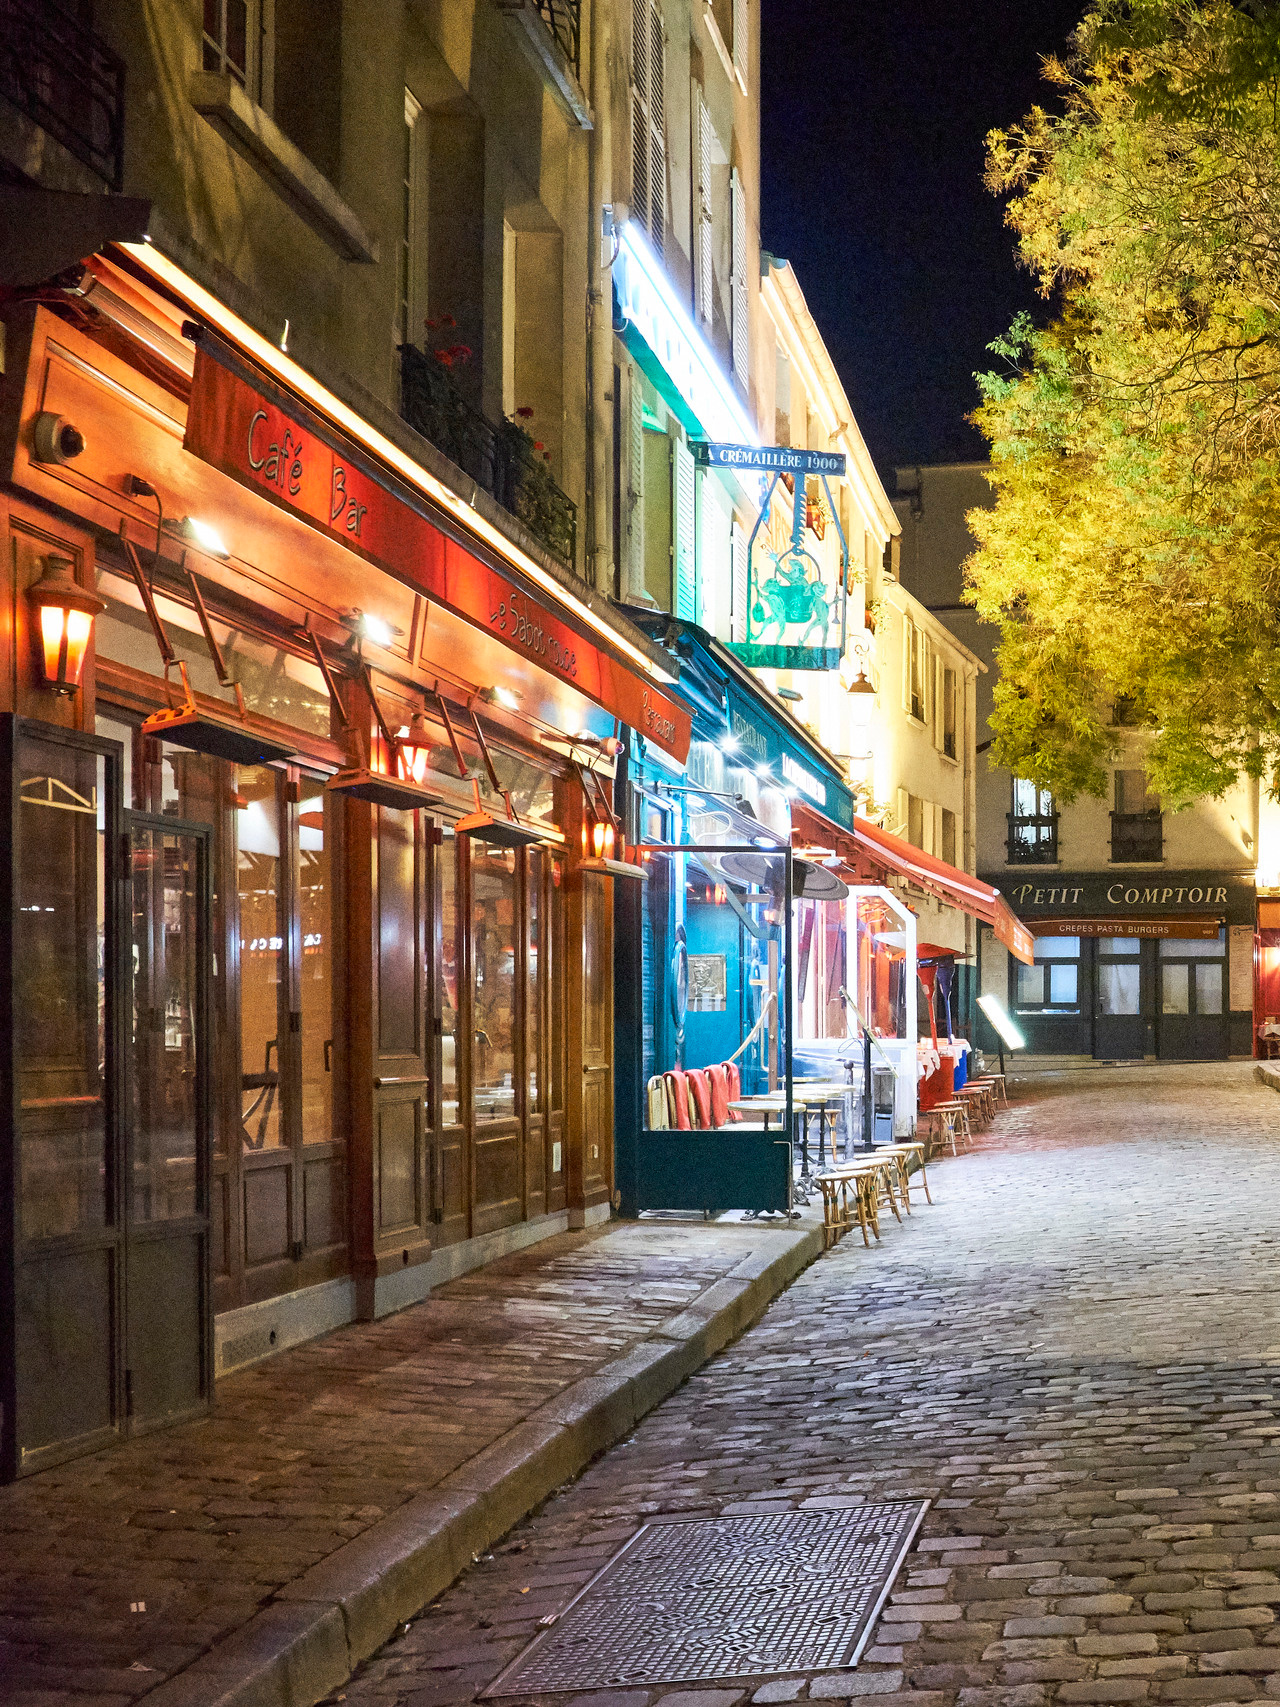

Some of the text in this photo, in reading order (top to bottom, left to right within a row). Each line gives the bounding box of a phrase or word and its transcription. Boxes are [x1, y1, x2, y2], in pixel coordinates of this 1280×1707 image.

[698, 447, 714, 461] LA
[807, 453, 838, 470] 1900
[248, 410, 367, 538] Café Bar
[1012, 884, 1228, 904] PETIT COMPTOIR
[1128, 926, 1169, 934] BURGERS
